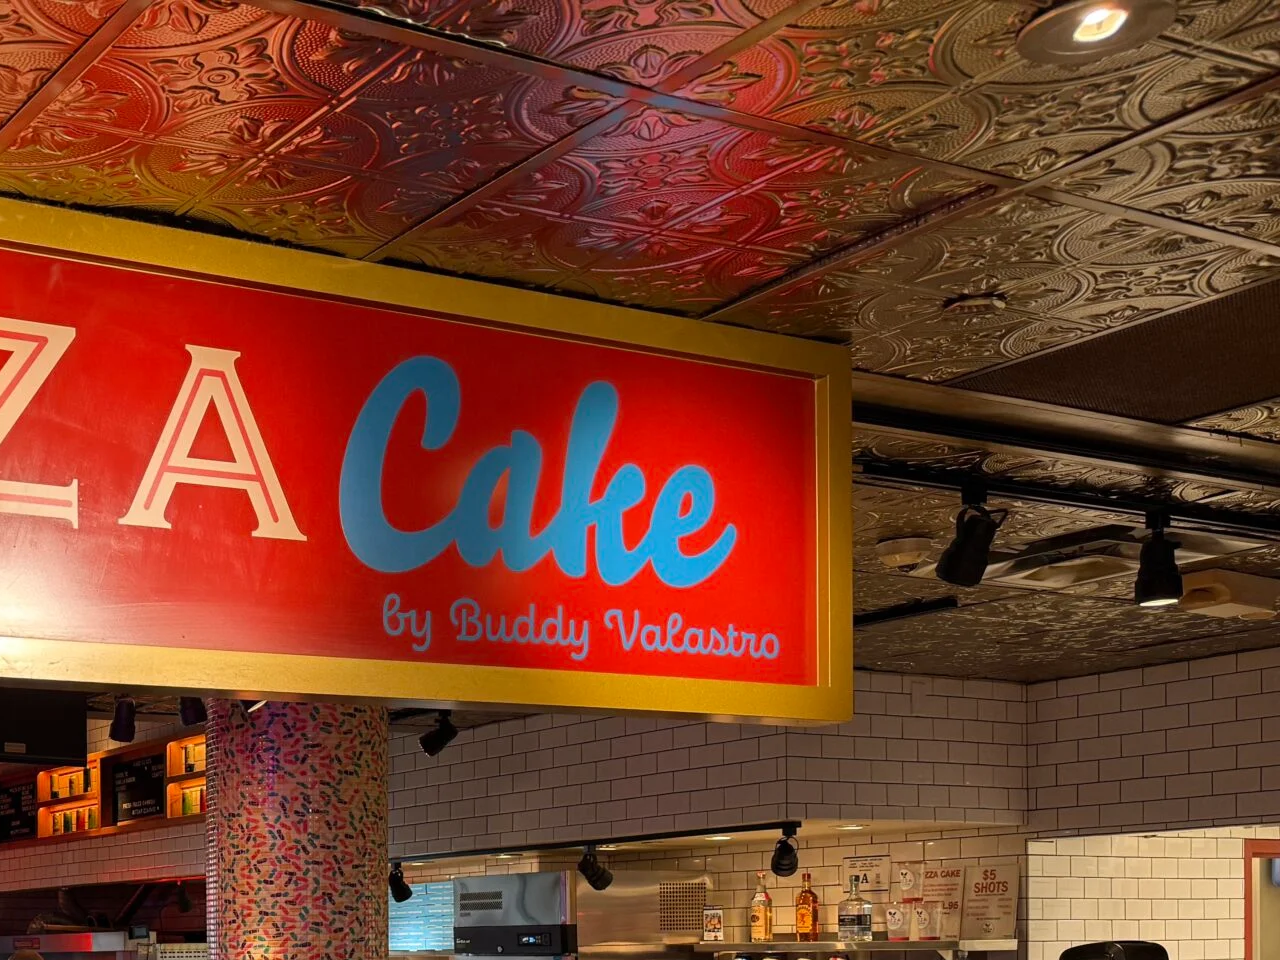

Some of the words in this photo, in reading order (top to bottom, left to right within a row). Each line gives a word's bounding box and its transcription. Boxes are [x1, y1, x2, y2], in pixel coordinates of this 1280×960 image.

[338, 355, 738, 589] Cake
[382, 593, 432, 652] by
[449, 598, 589, 661] Buddy
[604, 609, 780, 659] Valastro
[940, 870, 961, 878] CAKE
[982, 869, 996, 880] $5
[973, 881, 1009, 893] SHOTS
